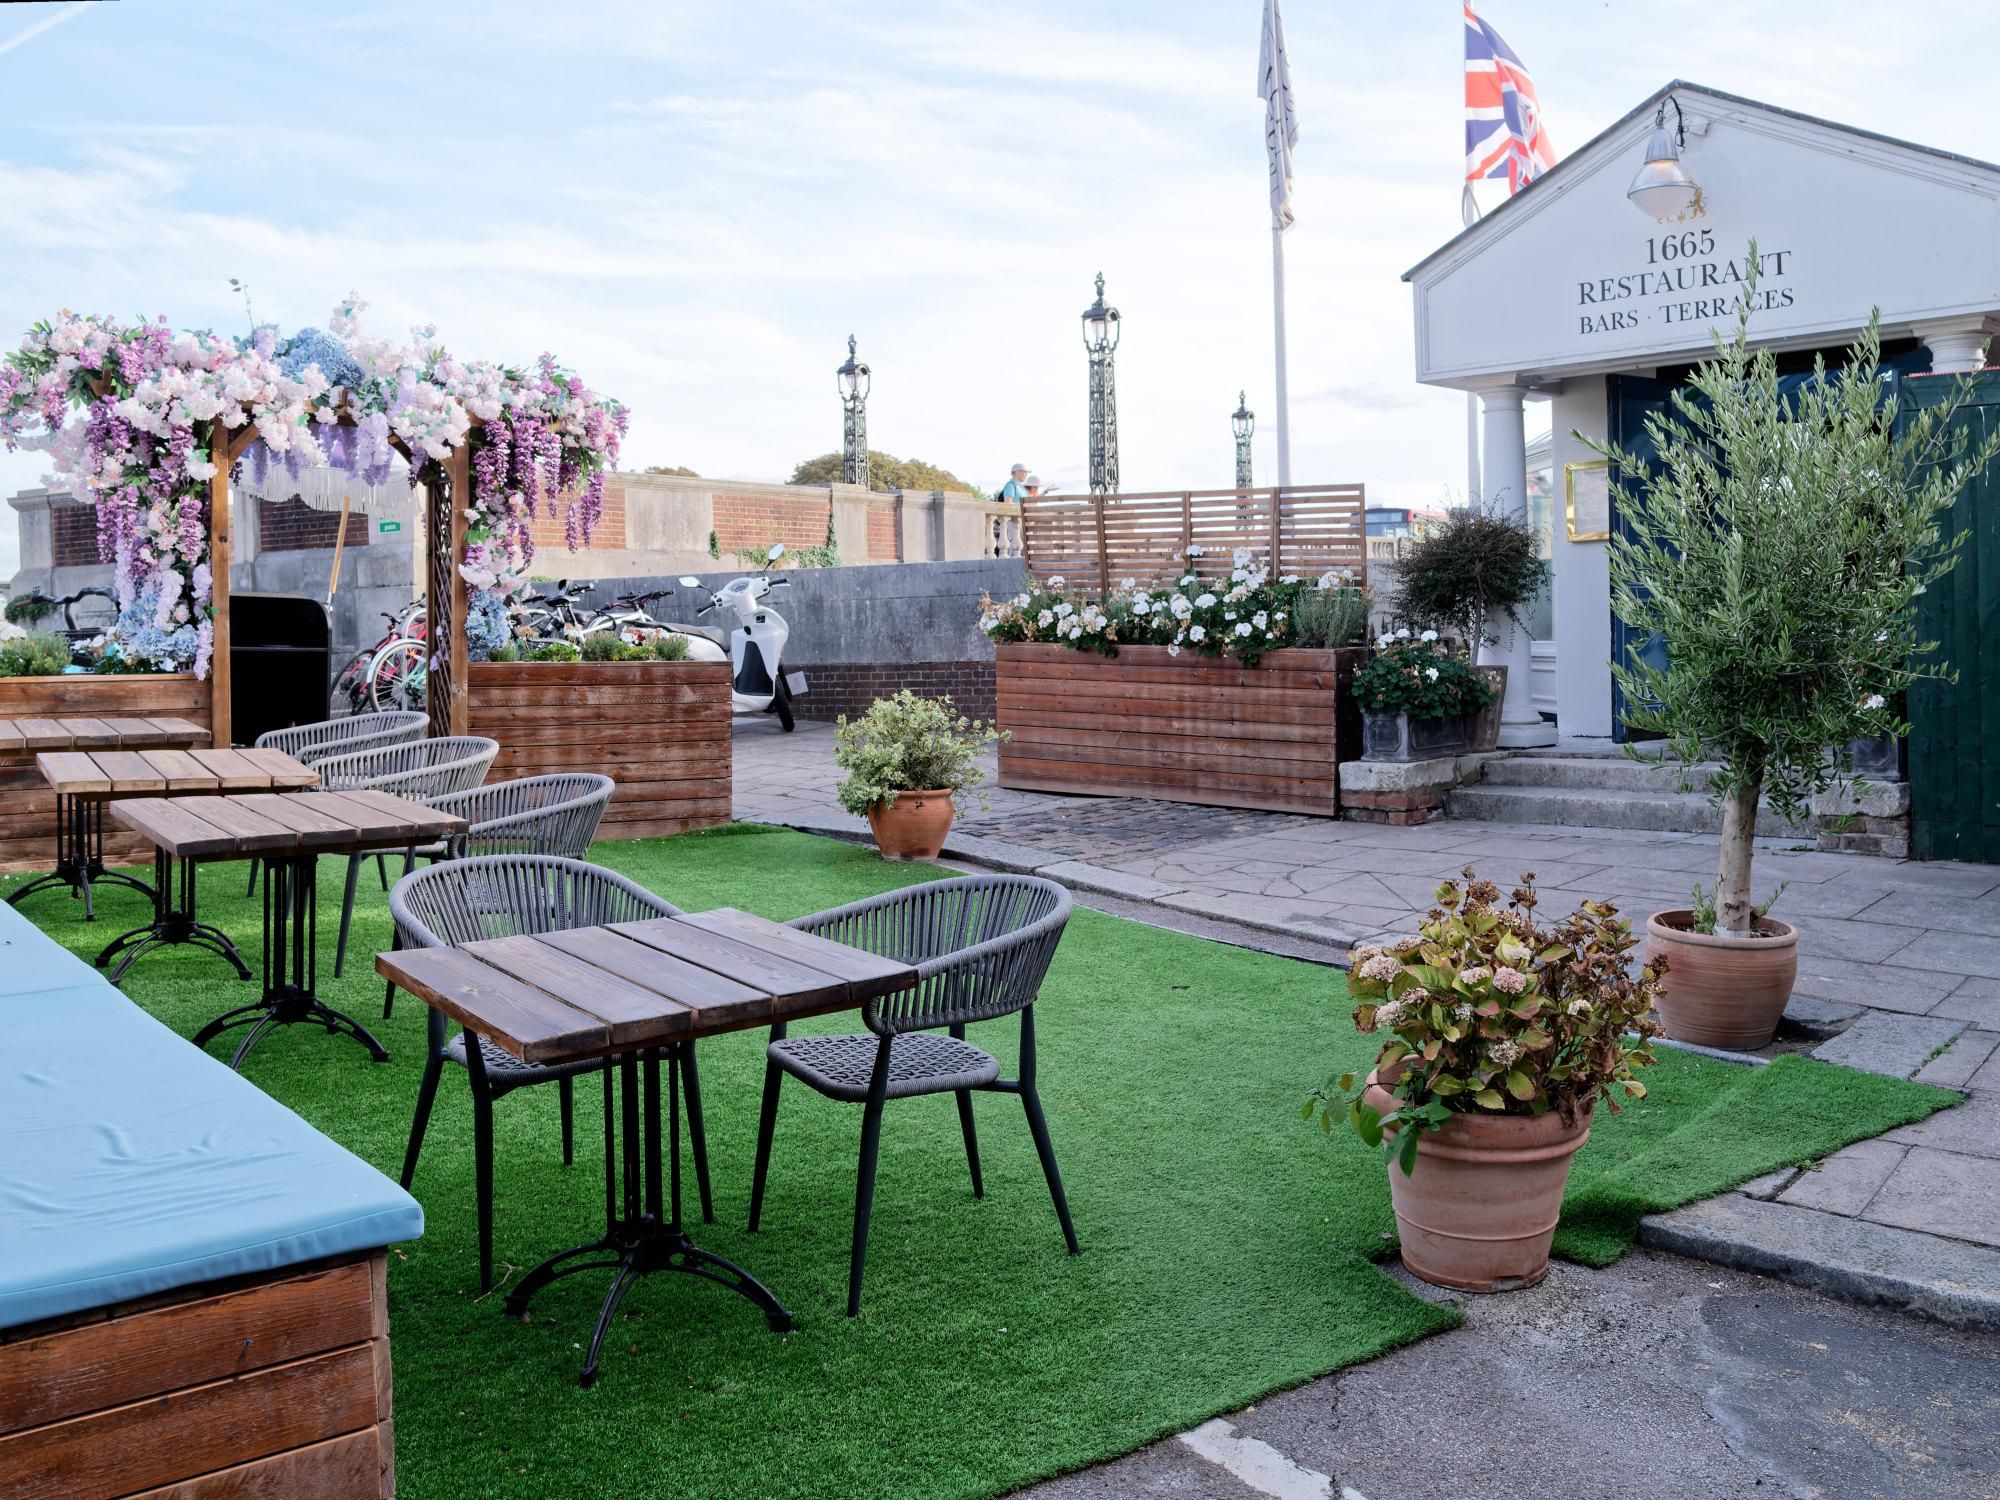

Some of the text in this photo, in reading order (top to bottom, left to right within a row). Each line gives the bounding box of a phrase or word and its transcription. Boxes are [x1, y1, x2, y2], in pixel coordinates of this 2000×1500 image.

[1646, 228, 1715, 264] 1665
[1578, 251, 1792, 305] RESTAURANT
[1579, 310, 1639, 334] BARS
